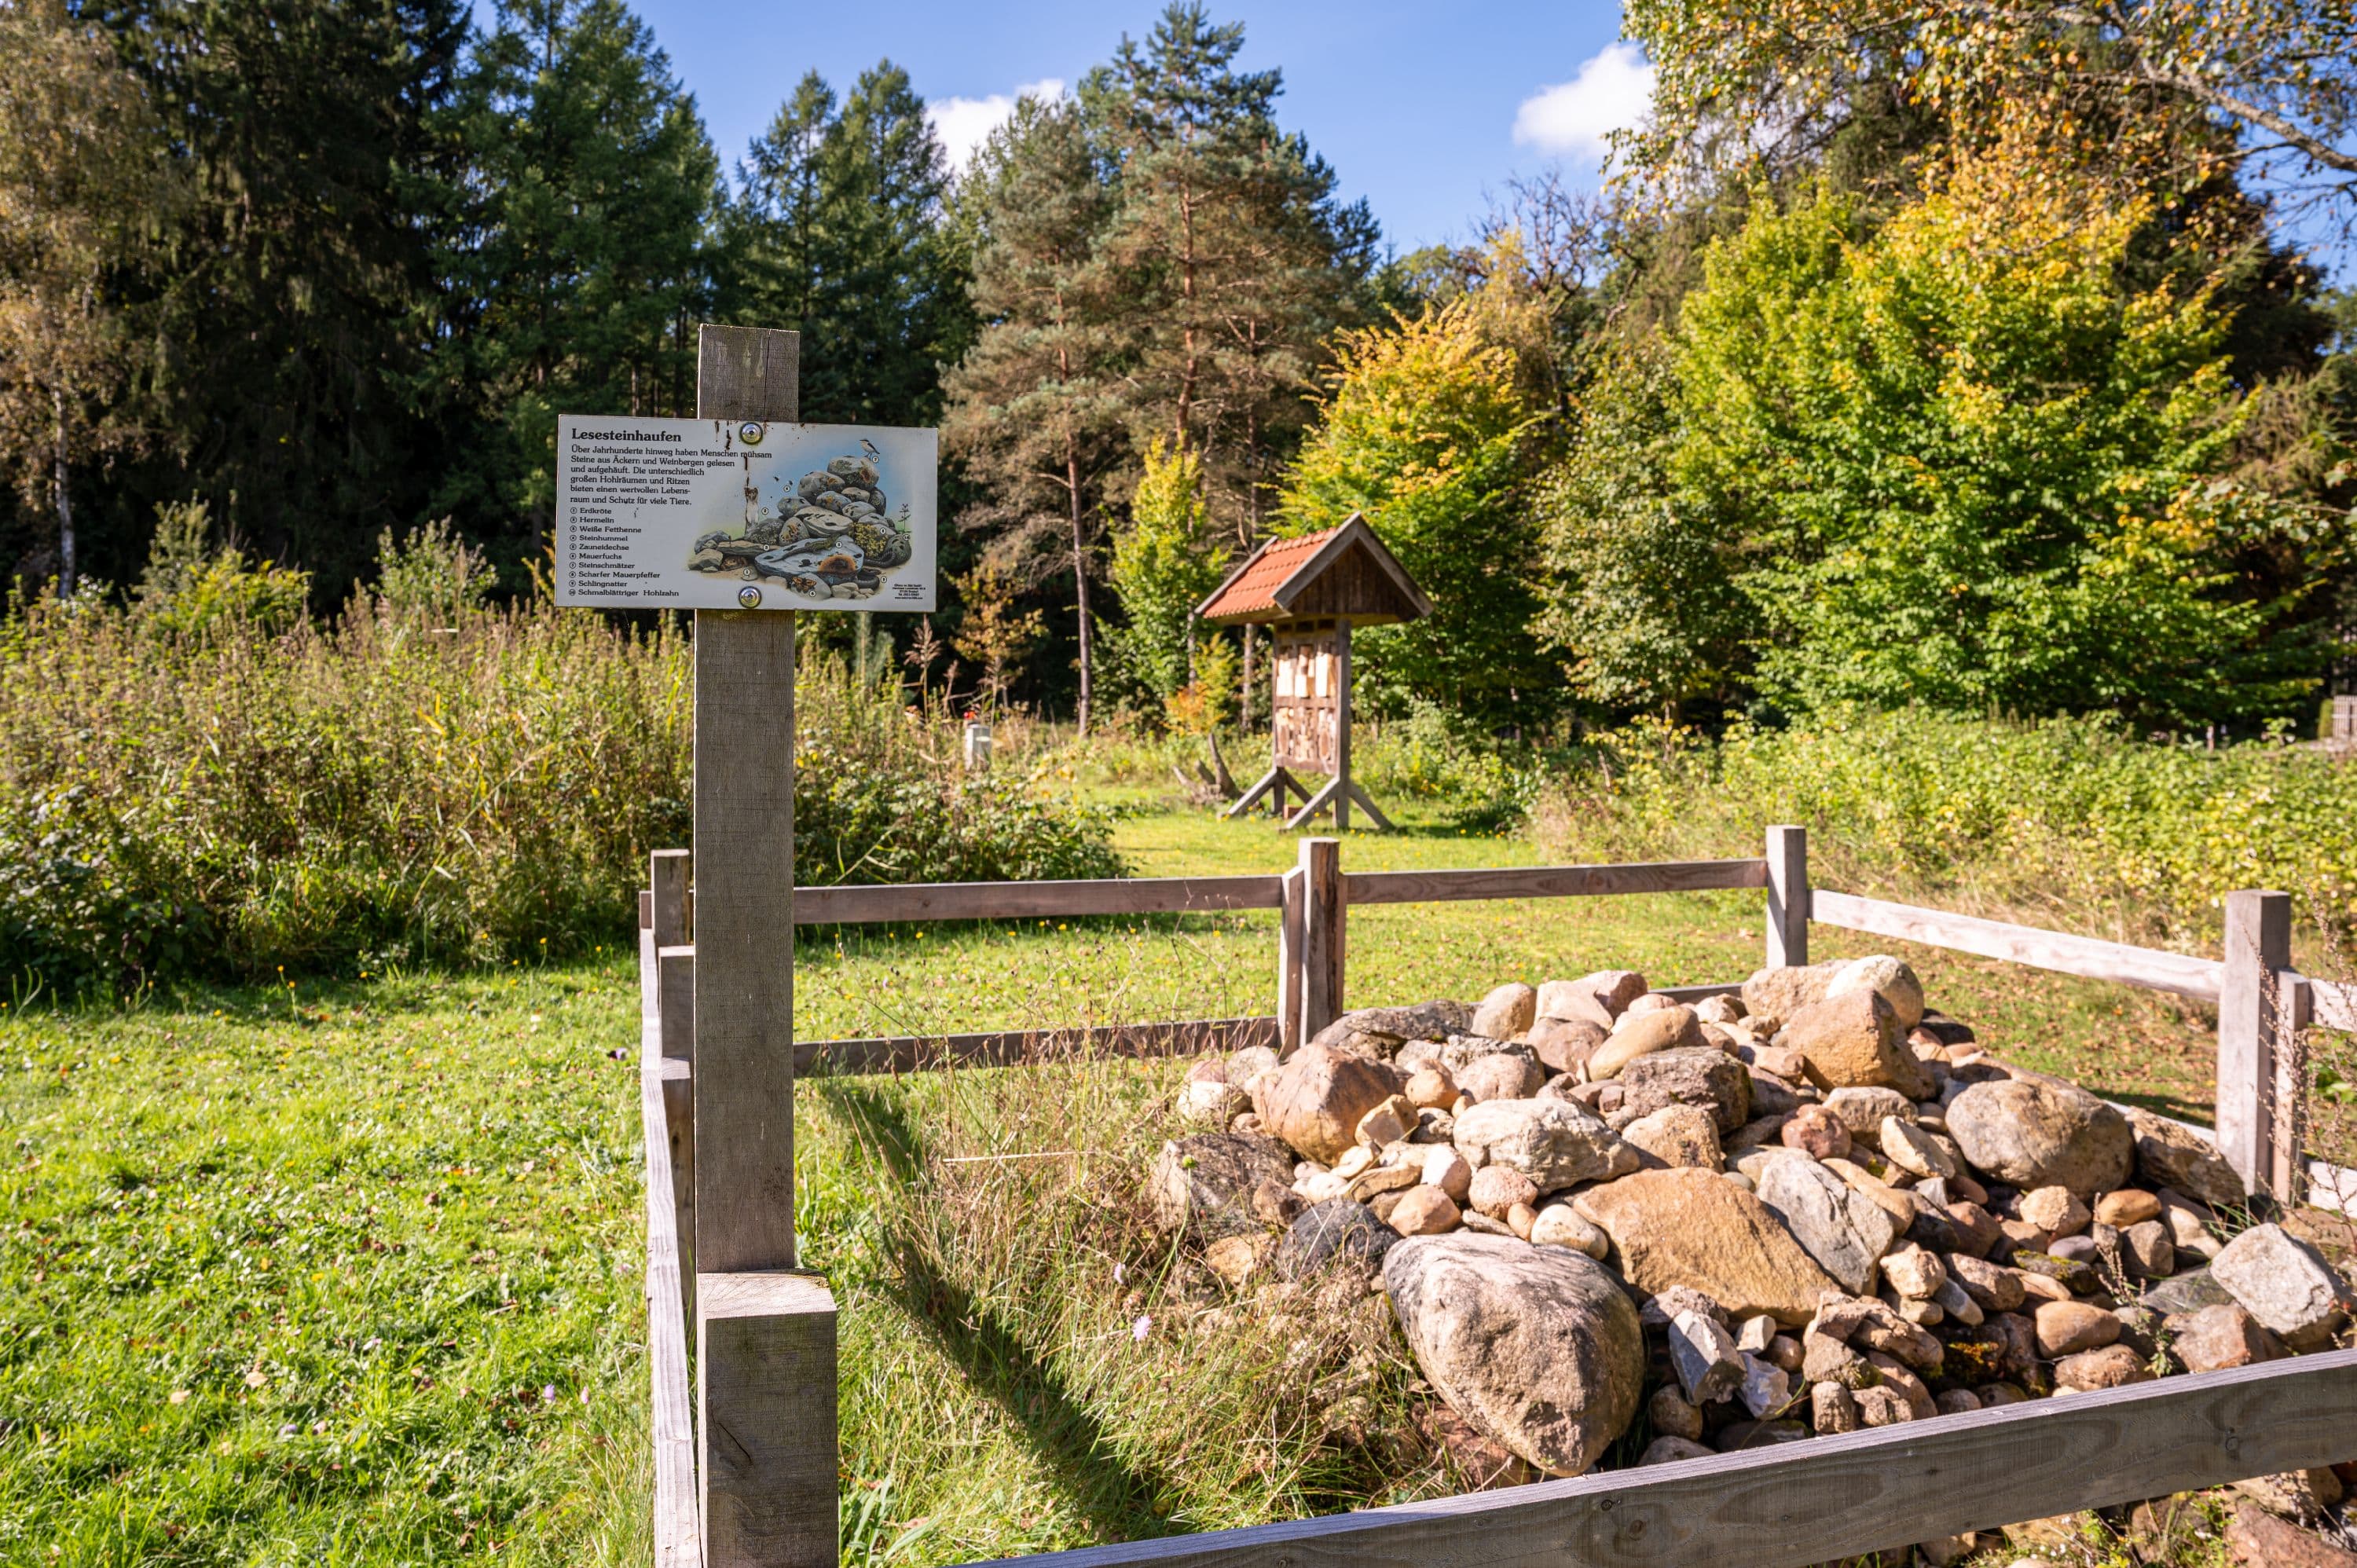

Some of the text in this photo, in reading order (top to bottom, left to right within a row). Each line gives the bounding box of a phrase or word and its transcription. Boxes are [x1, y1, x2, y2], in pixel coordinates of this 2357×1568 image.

[572, 428, 681, 442] Lesesteinhaufen
[571, 444, 590, 453] Über
[592, 446, 643, 455] Jahrhunderte
[645, 447, 673, 456] hinweg
[741, 450, 772, 459] mühsam
[613, 455, 640, 464] Äckern
[659, 457, 705, 467] Weinbergen
[706, 459, 735, 467] gelesen
[588, 466, 630, 474] aufgehäuft.
[570, 475, 597, 484] großen
[620, 485, 658, 493] wertvollen
[609, 496, 635, 504] Schutz
[636, 496, 647, 504] für
